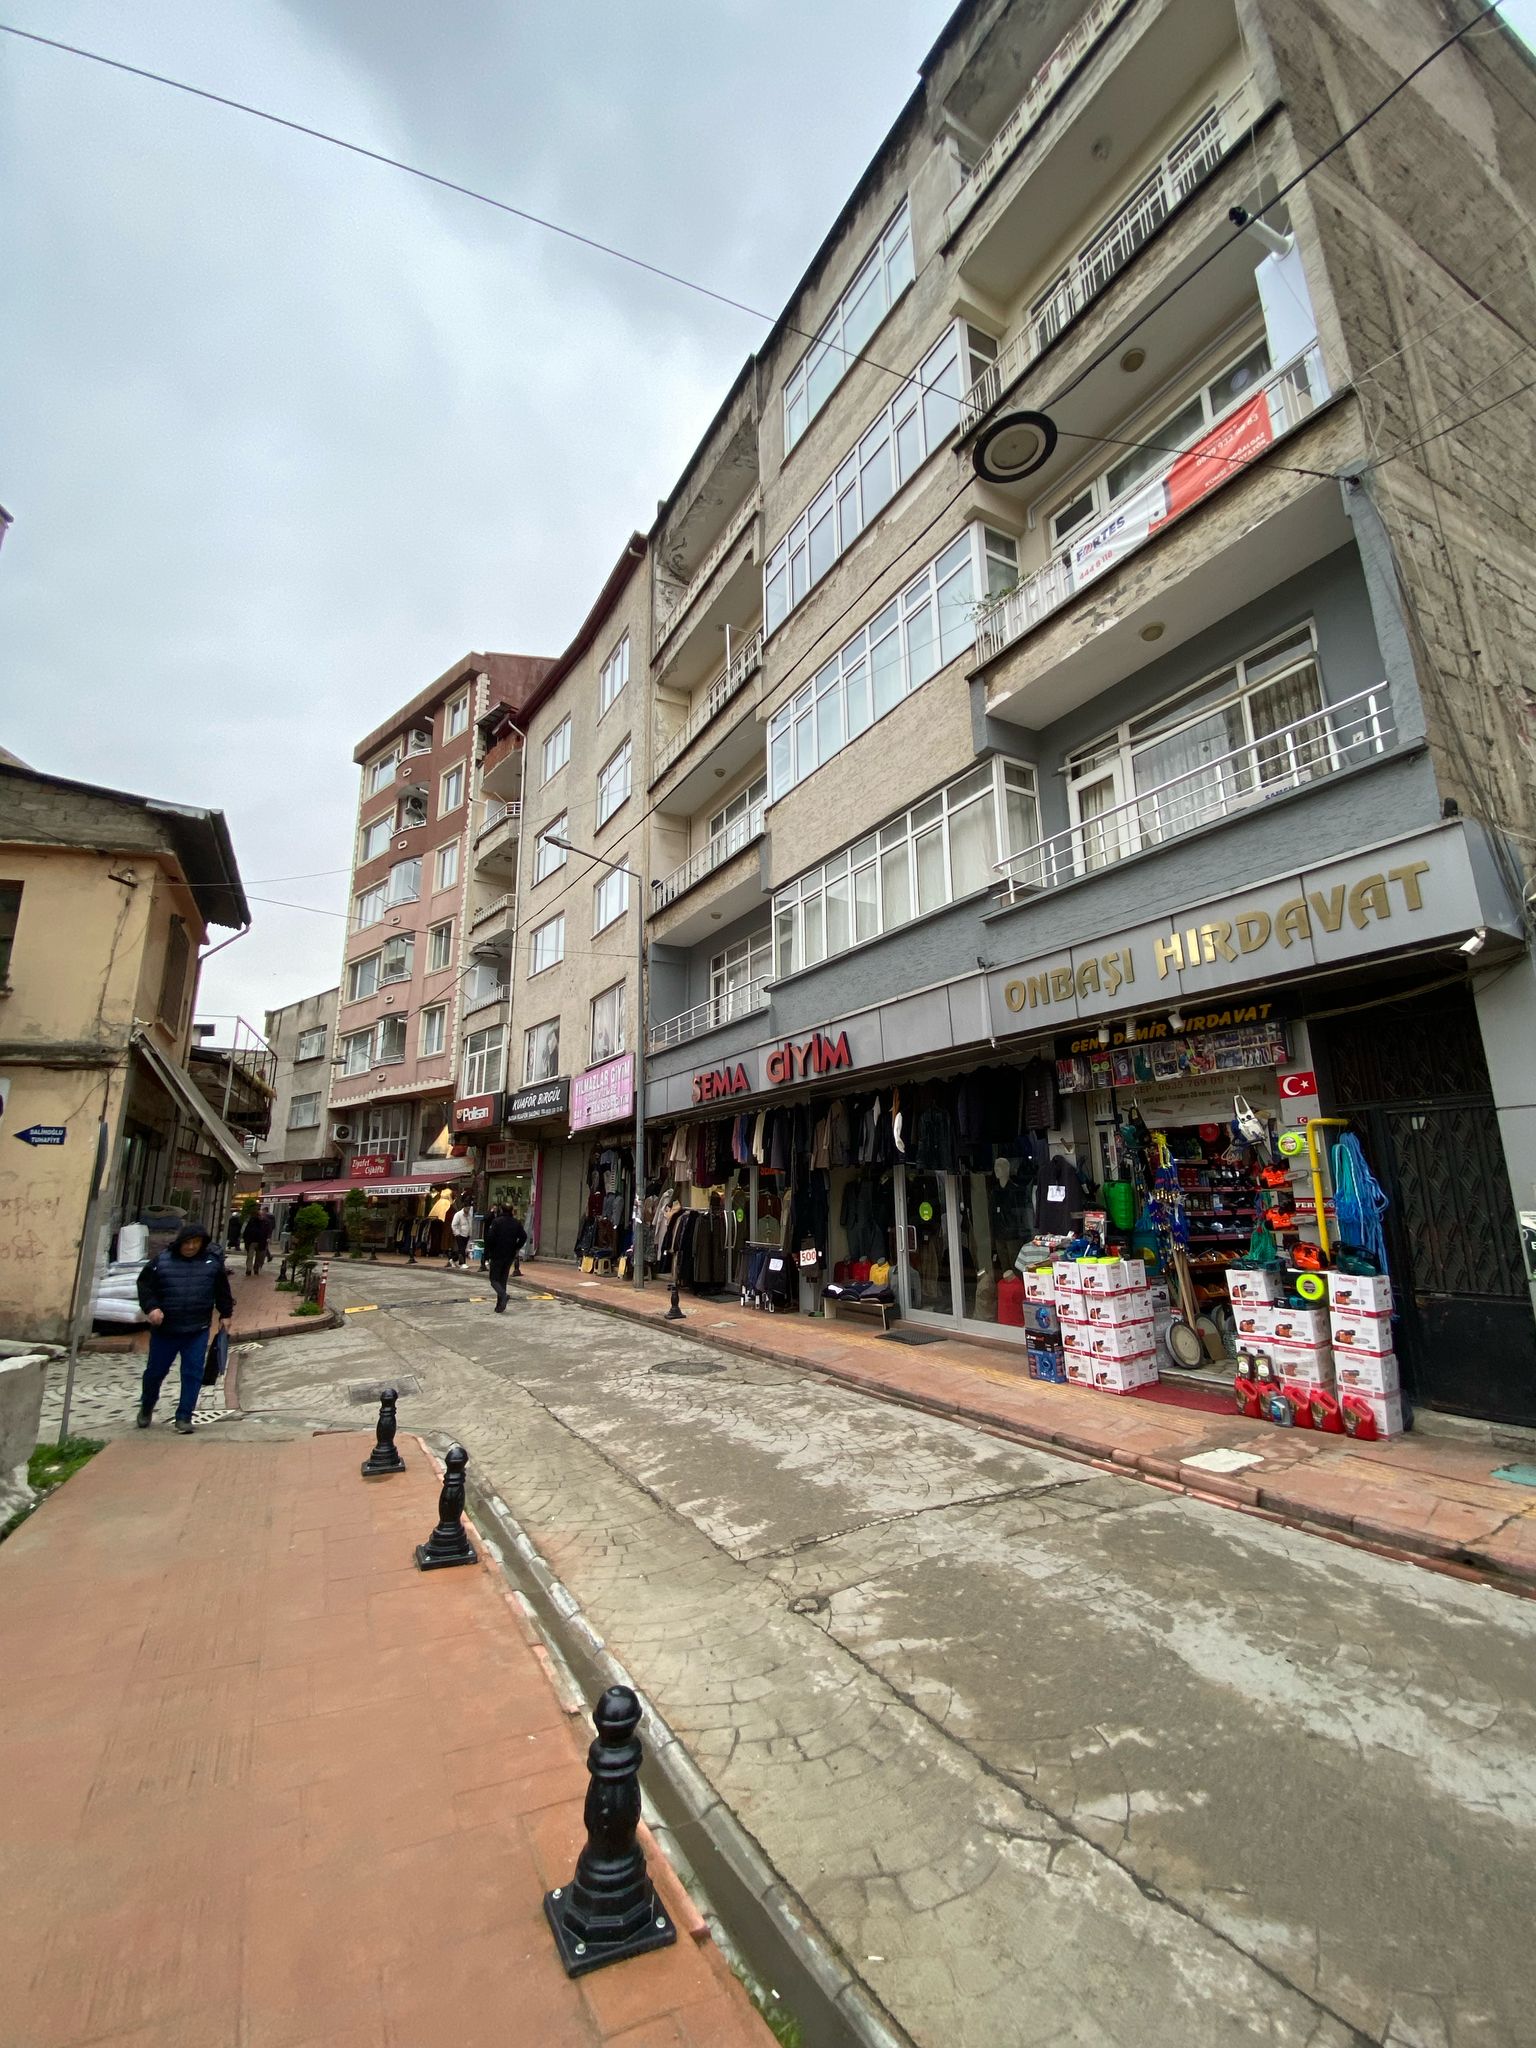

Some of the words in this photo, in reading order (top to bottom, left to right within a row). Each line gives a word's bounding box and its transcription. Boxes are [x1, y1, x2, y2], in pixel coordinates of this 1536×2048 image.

[1076, 515, 1126, 562] FORTES
[1004, 947, 1135, 1013] ONBAŞI
[1153, 860, 1430, 979] HIRDAVAT
[1113, 1021, 1167, 1045] DMİR
[691, 1063, 752, 1104] SEMA
[766, 1030, 853, 1084] GİYİM
[463, 1106, 489, 1122] Polisan
[512, 1093, 538, 1111] KUAFÖR
[537, 1086, 562, 1105] BİRGÜL
